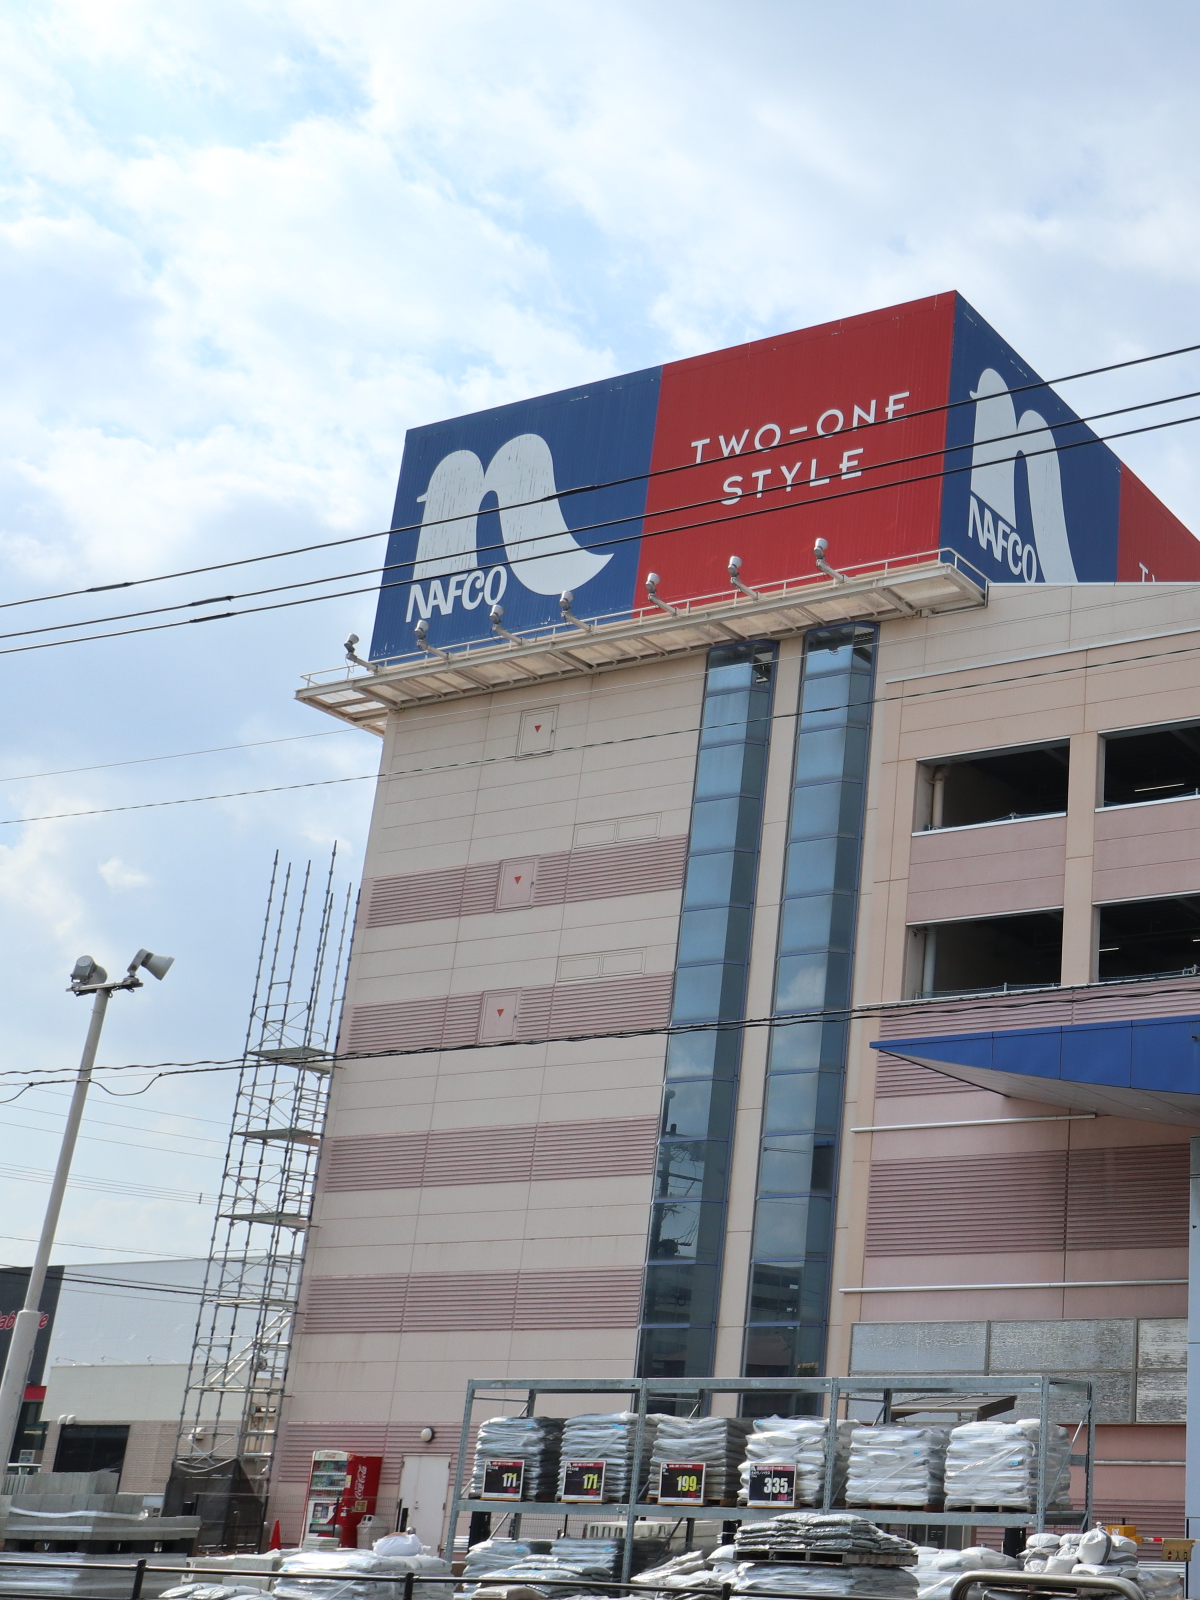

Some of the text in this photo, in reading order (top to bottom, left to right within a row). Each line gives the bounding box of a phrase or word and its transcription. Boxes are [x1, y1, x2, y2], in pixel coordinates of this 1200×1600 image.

[691, 391, 909, 464] TWO-ONE
[721, 448, 864, 505] STYLE
[967, 495, 1037, 583] NAFCO
[405, 565, 508, 623] NAFCO
[502, 1472, 517, 1488] 171
[583, 1473, 598, 1490] 171
[676, 1475, 697, 1492] 199
[763, 1477, 788, 1494] 335
